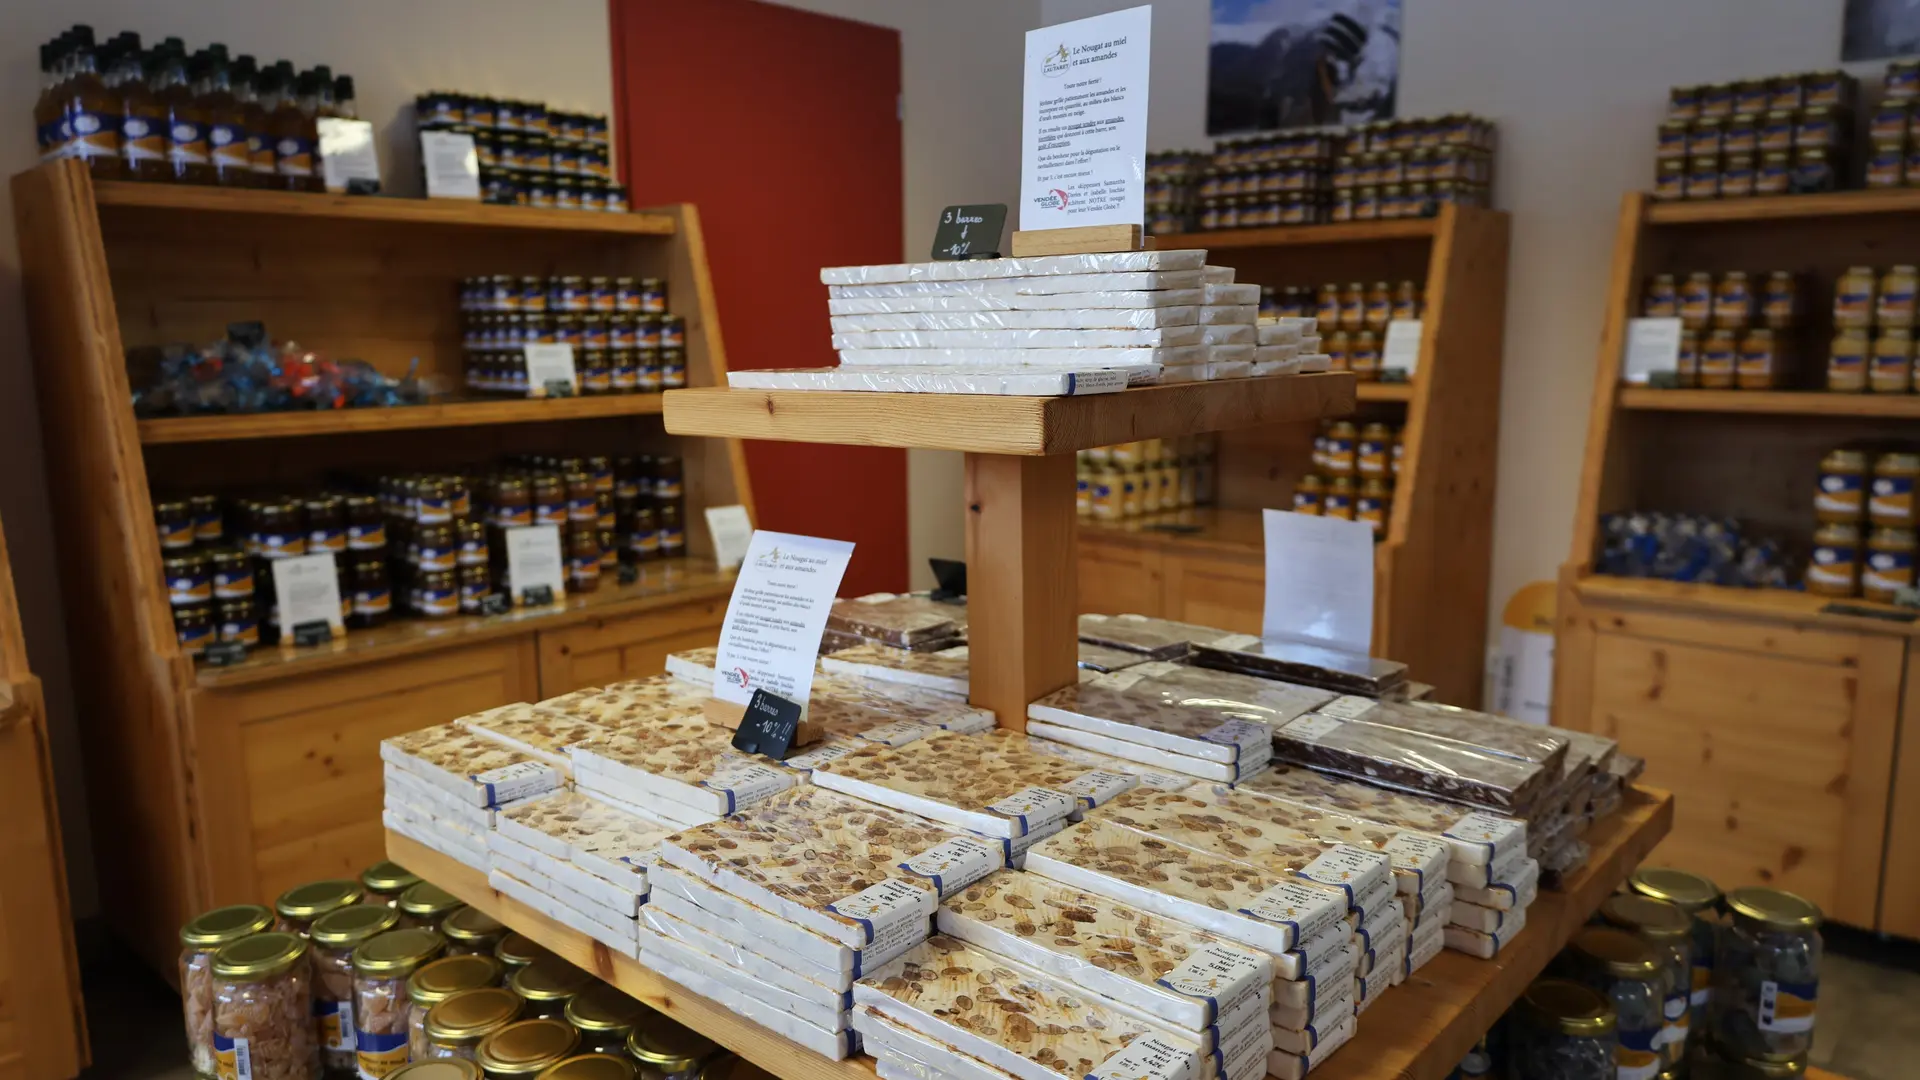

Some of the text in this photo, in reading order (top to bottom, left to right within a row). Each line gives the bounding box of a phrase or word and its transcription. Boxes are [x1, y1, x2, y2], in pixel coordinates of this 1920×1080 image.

[1082, 44, 1103, 53] Nougat
[1114, 36, 1127, 46] miel
[1091, 51, 1117, 62] amandes
[1044, 64, 1068, 73] LAUTARET
[944, 208, 983, 224] 3 barres
[943, 241, 971, 255] -10%
[791, 554, 808, 563] Nougat
[754, 693, 779, 716] 3 barres
[756, 720, 780, 738] -10%
[1204, 949, 1235, 962] Amandes
[1215, 947, 1239, 958] Nougat
[1171, 981, 1212, 996] LAUTARET
[1151, 1039, 1177, 1052] Nougat
[1140, 1041, 1171, 1057] Amandes
[1184, 1060, 1190, 1070] au
[1153, 1054, 1170, 1064] Miel
